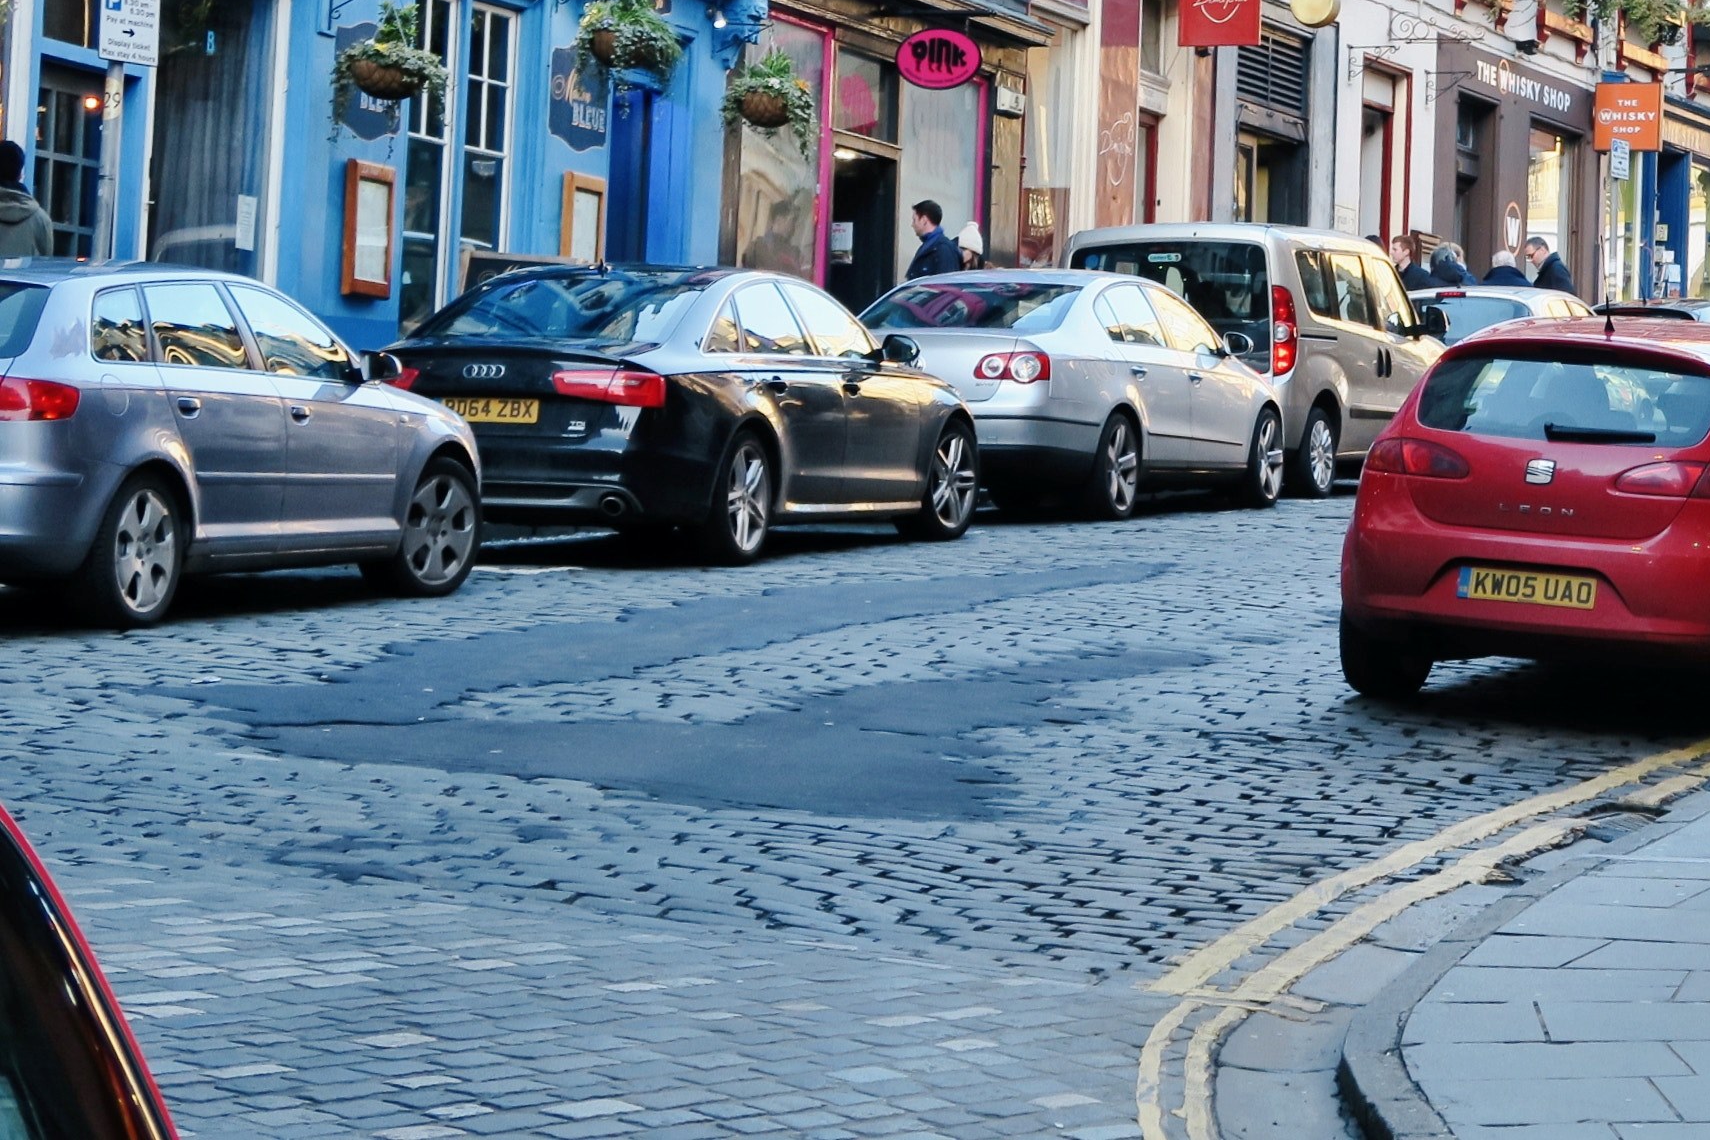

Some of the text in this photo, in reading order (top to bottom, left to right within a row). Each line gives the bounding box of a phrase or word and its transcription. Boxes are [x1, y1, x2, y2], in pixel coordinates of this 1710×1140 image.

[106, 15, 117, 24] Pay
[128, 18, 154, 29] machine
[107, 38, 151, 51] Display ticket
[101, 48, 115, 57] Max
[116, 50, 131, 60] stay
[138, 53, 156, 63] hours
[1477, 60, 1571, 113] THE WHISKY SHOP
[104, 92, 121, 109] 29
[1617, 99, 1638, 107] THE
[572, 102, 606, 133] BLEUE
[1600, 111, 1656, 122] WHISKY
[1612, 126, 1641, 134] SHOP
[1506, 216, 1520, 248] W
[496, 399, 534, 419] ZBX
[1473, 571, 1593, 604] KW05 UAO
